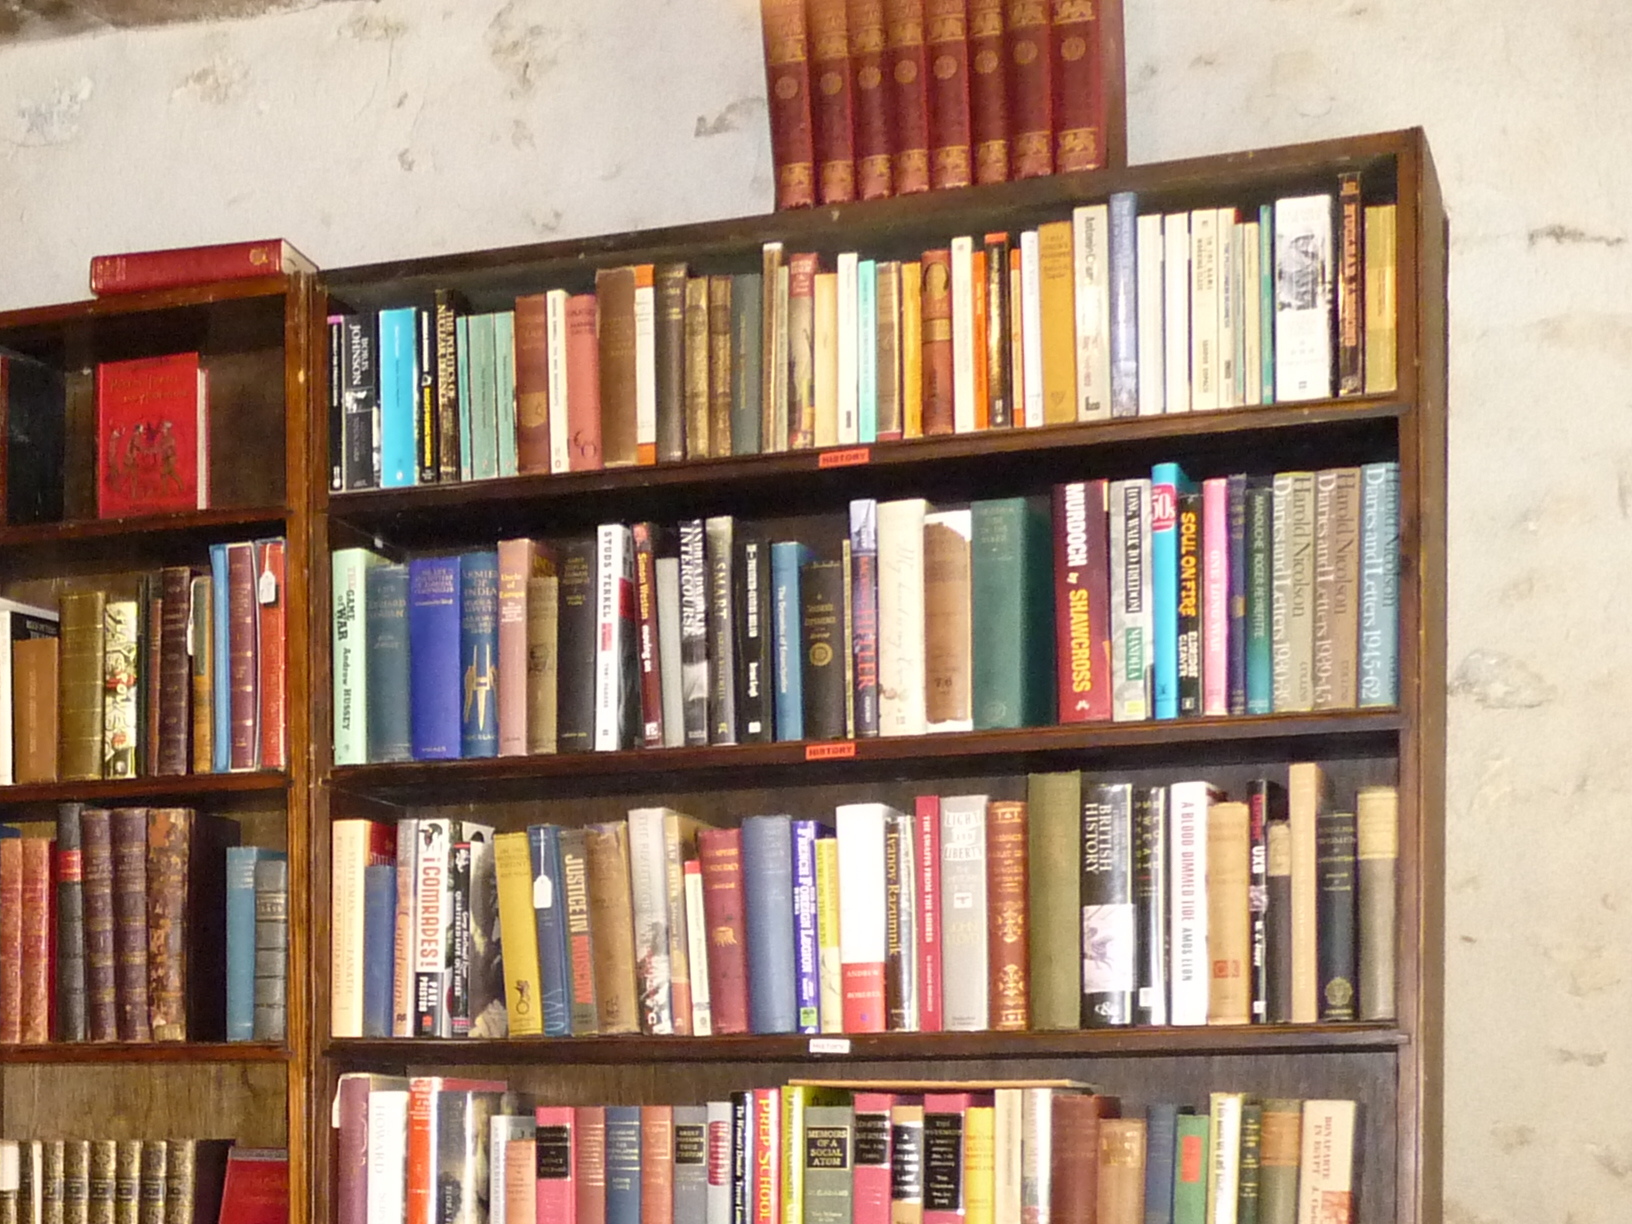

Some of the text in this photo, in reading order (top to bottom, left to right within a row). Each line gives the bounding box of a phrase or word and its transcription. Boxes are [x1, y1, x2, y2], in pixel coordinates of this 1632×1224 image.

[350, 324, 364, 386] JOHNSON
[360, 336, 369, 372] BORIS
[821, 452, 867, 465] HISTORY
[1178, 512, 1196, 617] SOUL ON FIRE
[1273, 479, 1291, 640] Diaries and Letters
[1291, 476, 1314, 618] Harold Nicolson
[1315, 473, 1336, 637] Diaries and Letters
[1333, 472, 1356, 615] Harold Nicolson
[1363, 466, 1384, 628] Diaries and Letters
[1381, 464, 1399, 609] Harold Nicolson
[345, 590, 356, 622] GAME
[602, 530, 613, 618] STUDS TERKEL
[638, 552, 650, 620] Simon Weston
[679, 526, 694, 637] INTERCOURSE
[714, 562, 728, 620] SMART
[1064, 483, 1091, 693] MURDOCH by SHAWCROSS
[1127, 561, 1143, 612] FREEDOM
[335, 607, 348, 641] WAR
[640, 624, 652, 673] moving on
[857, 609, 877, 691] HITLER
[1127, 628, 1142, 680] MANDELA
[341, 647, 352, 731] Andrew HUSSEY
[808, 744, 853, 756] HISTORY
[1084, 802, 1099, 874] HISTORY
[1099, 804, 1113, 871] BRITISH
[1251, 845, 1265, 874] UXB
[565, 854, 589, 933] JUSTICE IN
[797, 827, 815, 974] FRENCH LEGION
[1182, 900, 1195, 922] TIDE
[1181, 926, 1193, 956] AMOS
[758, 1098, 772, 1222] PREP SCHOOL
[807, 1129, 847, 1139] MEMOIRS
[810, 1148, 843, 1157] SOCIAL
[813, 1157, 841, 1166] ATOM
[1322, 1116, 1333, 1180] BONAPARTE
